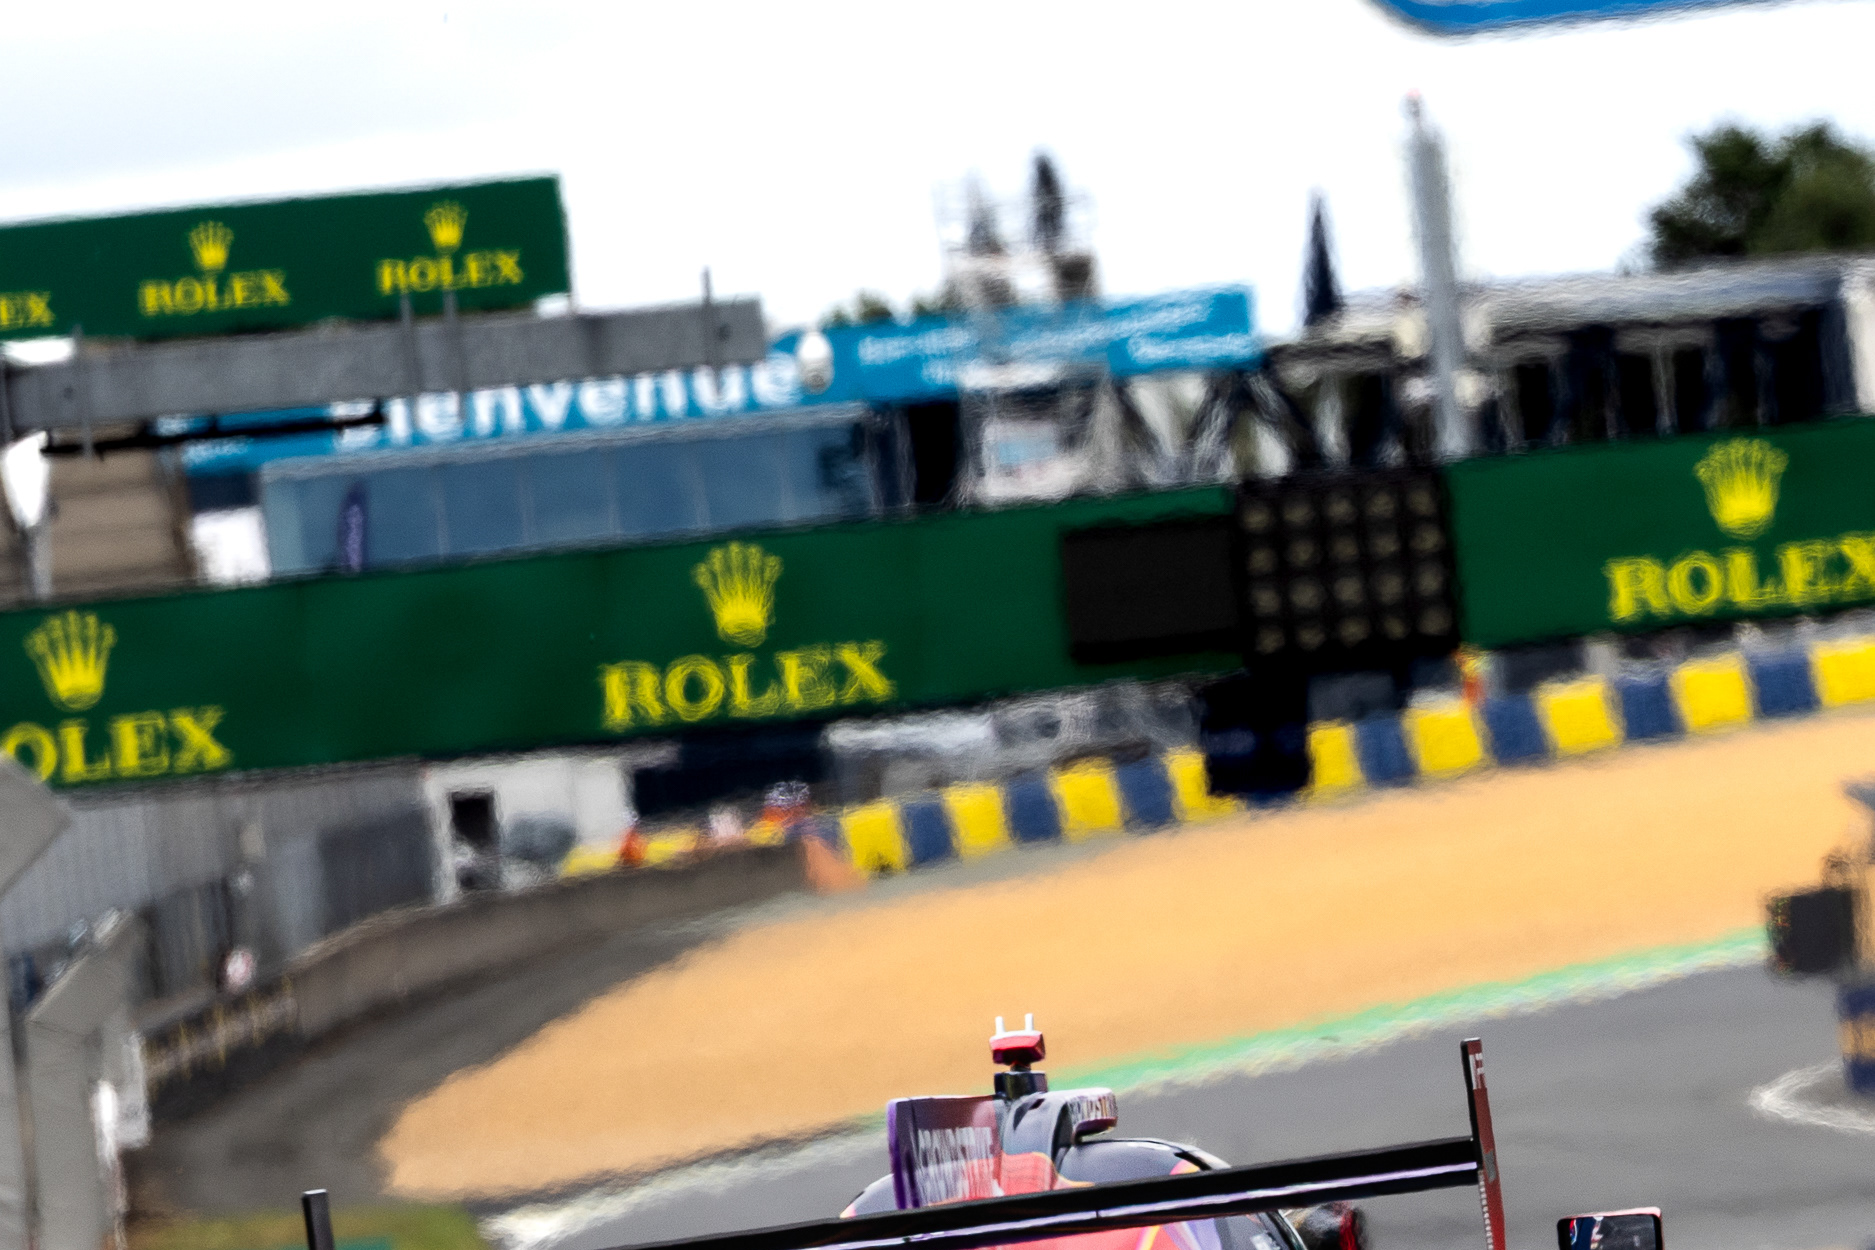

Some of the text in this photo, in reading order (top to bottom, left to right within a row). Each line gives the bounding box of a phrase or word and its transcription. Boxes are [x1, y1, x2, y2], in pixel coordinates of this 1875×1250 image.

[138, 269, 290, 317] ROLEX
[376, 249, 522, 296] ROLEX
[1605, 532, 1875, 623] ROLEX
[601, 641, 895, 732] ROLEX
